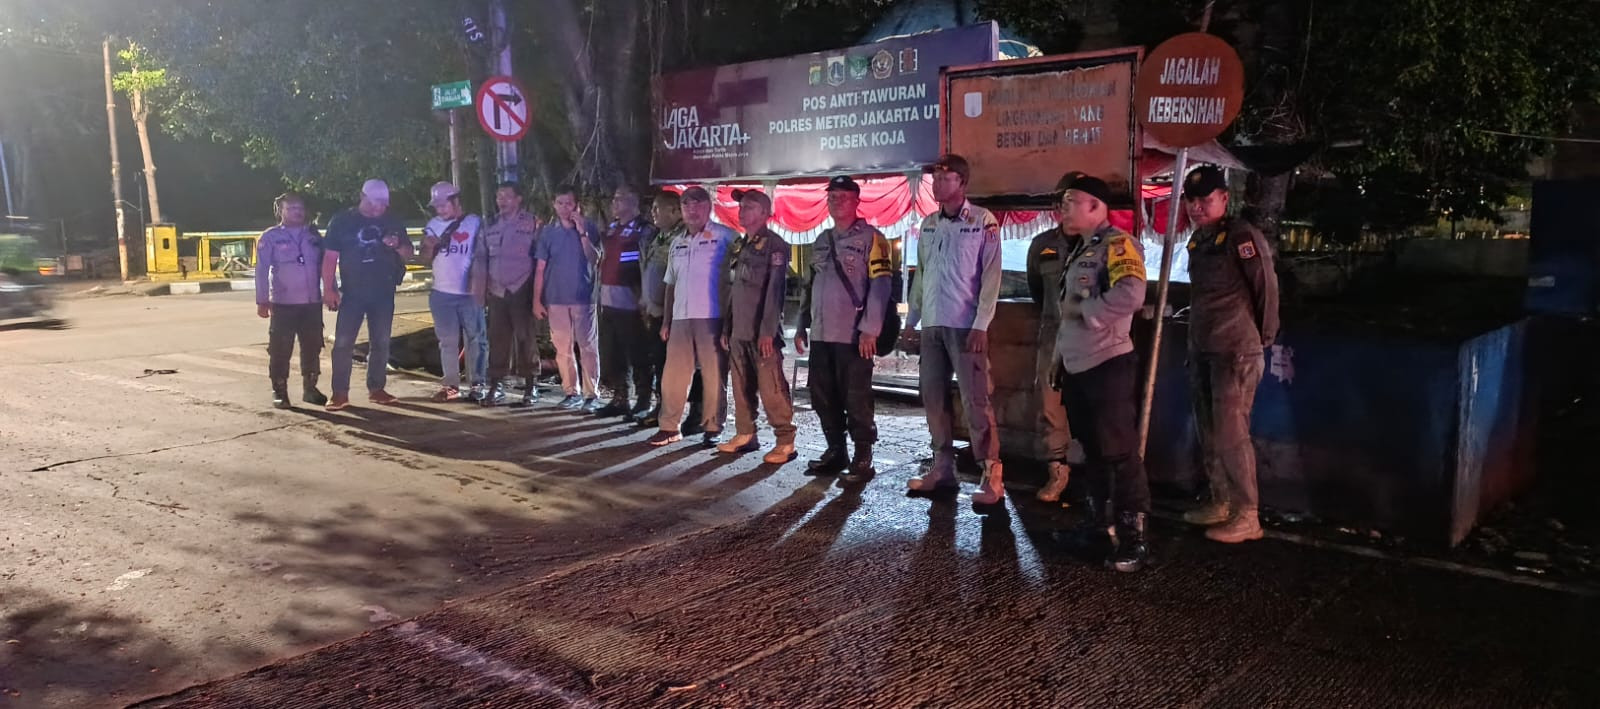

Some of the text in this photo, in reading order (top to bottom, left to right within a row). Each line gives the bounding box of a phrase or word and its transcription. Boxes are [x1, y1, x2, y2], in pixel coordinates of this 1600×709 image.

[1160, 57, 1220, 85] JAGALAH
[803, 97, 826, 111] POS
[1148, 96, 1226, 124] KEBERSIHAN
[769, 118, 813, 135] POLRES
[815, 113, 857, 131] METRO
[860, 107, 919, 126] JAKARTA
[820, 129, 906, 151] POLSEK KOJA
